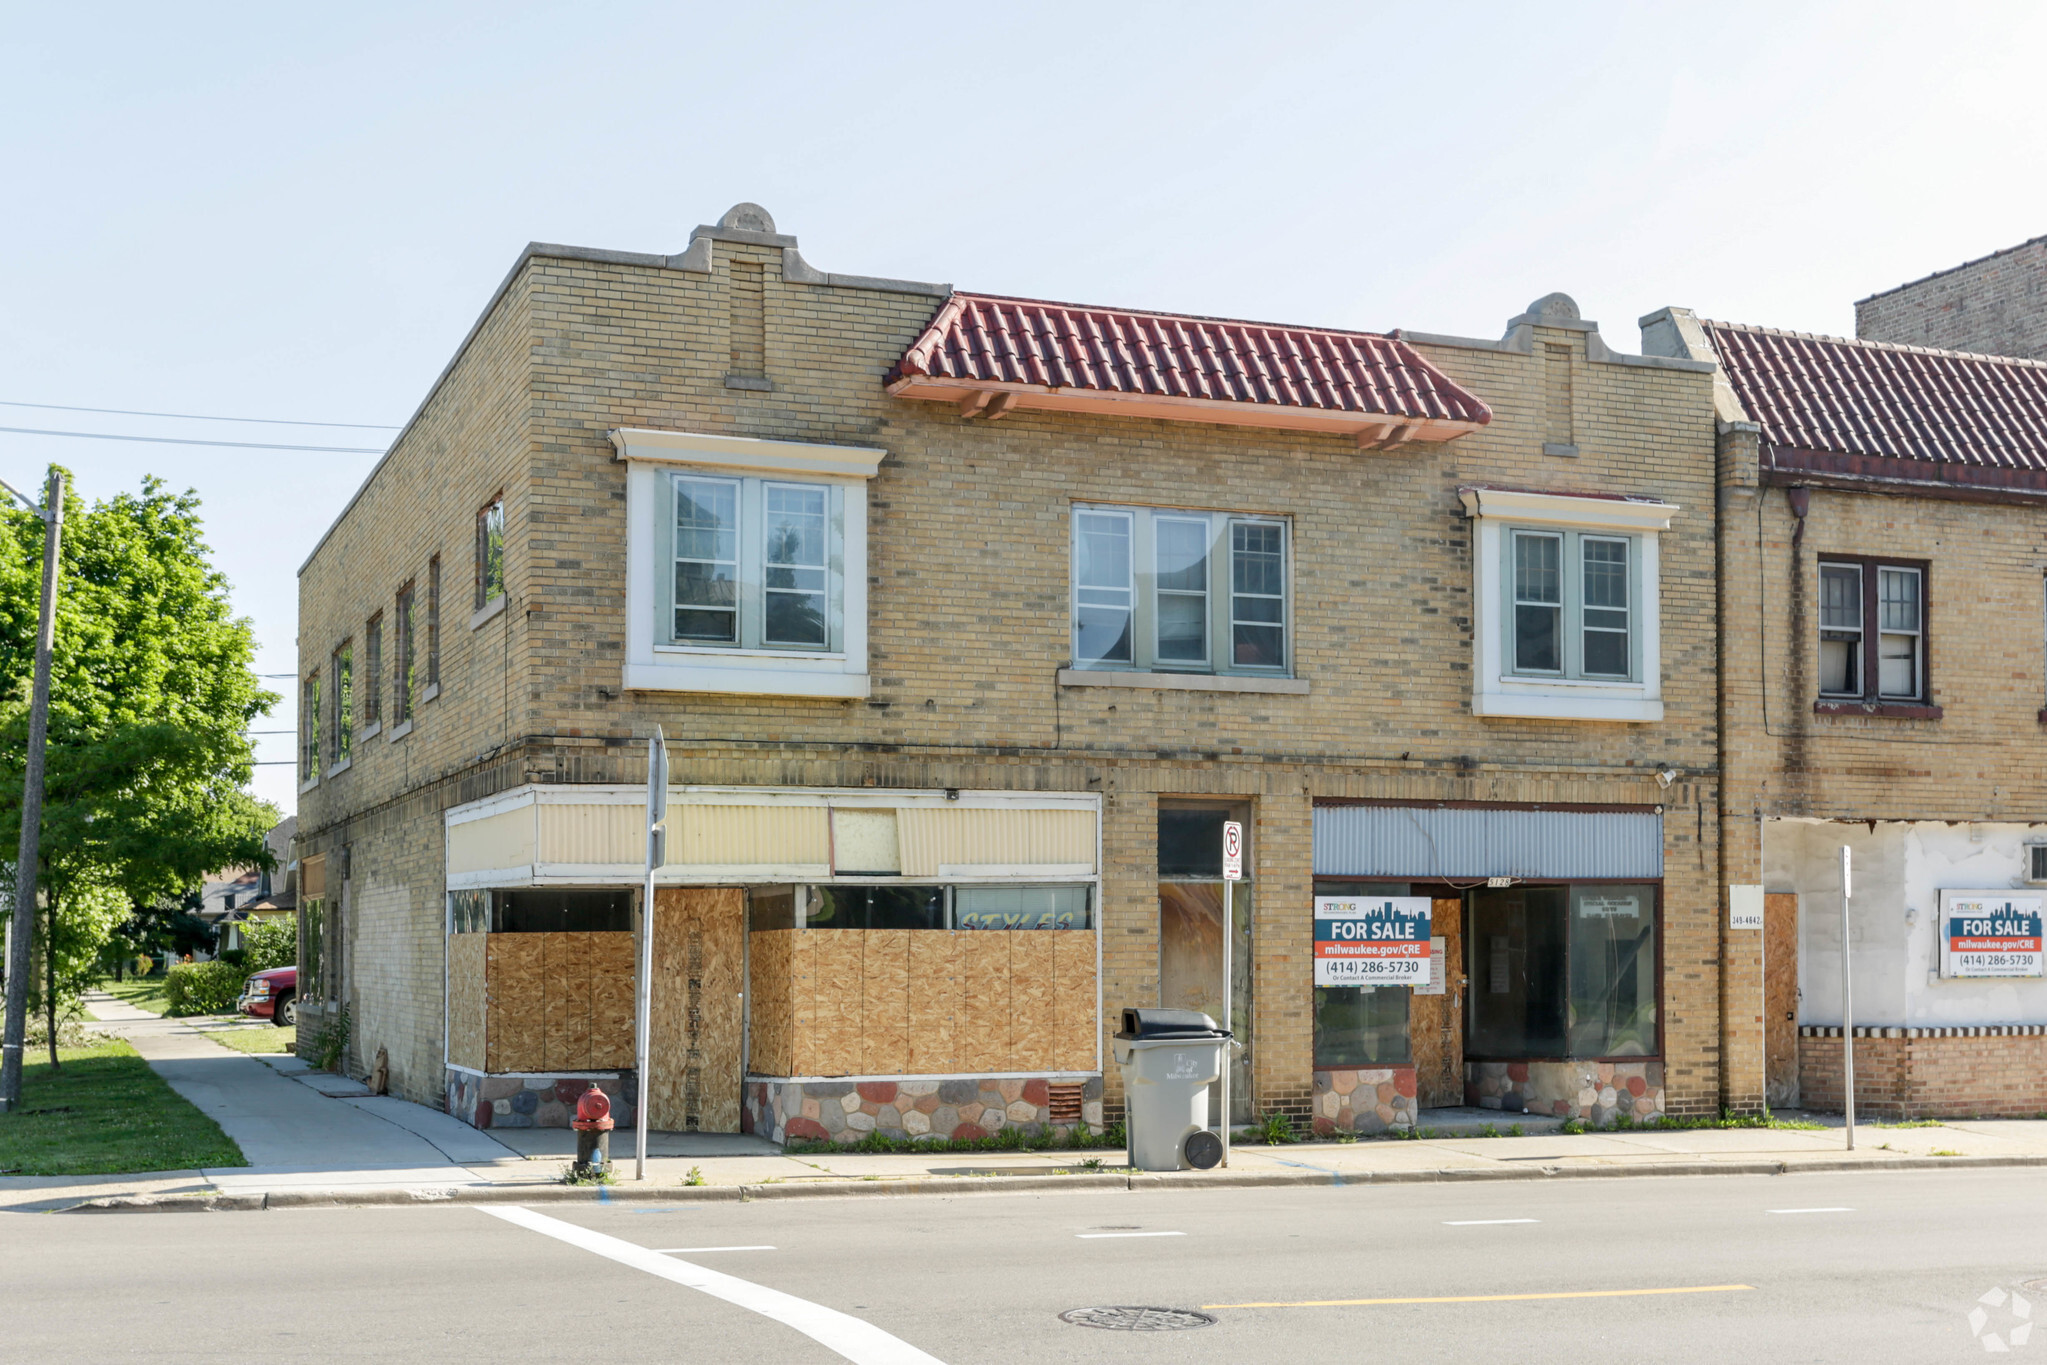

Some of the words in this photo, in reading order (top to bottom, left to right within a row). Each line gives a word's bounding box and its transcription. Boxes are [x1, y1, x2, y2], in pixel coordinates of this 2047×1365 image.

[1323, 903, 1356, 911] STRONG
[1956, 903, 1983, 911] STRONG
[1331, 922, 1368, 939] FOR
[1371, 922, 1415, 939] SALE
[1963, 920, 1992, 936] FOR
[1995, 920, 2030, 936] SALE
[1325, 944, 1421, 957] milwaukee.gov/CRE
[1958, 939, 2034, 951] milwaukee.gov/CRE
[1960, 954, 1985, 967] (414)
[1988, 955, 2034, 966] 286-5730
[1326, 961, 1358, 975] (414)
[1361, 961, 1419, 973] 286-5730
